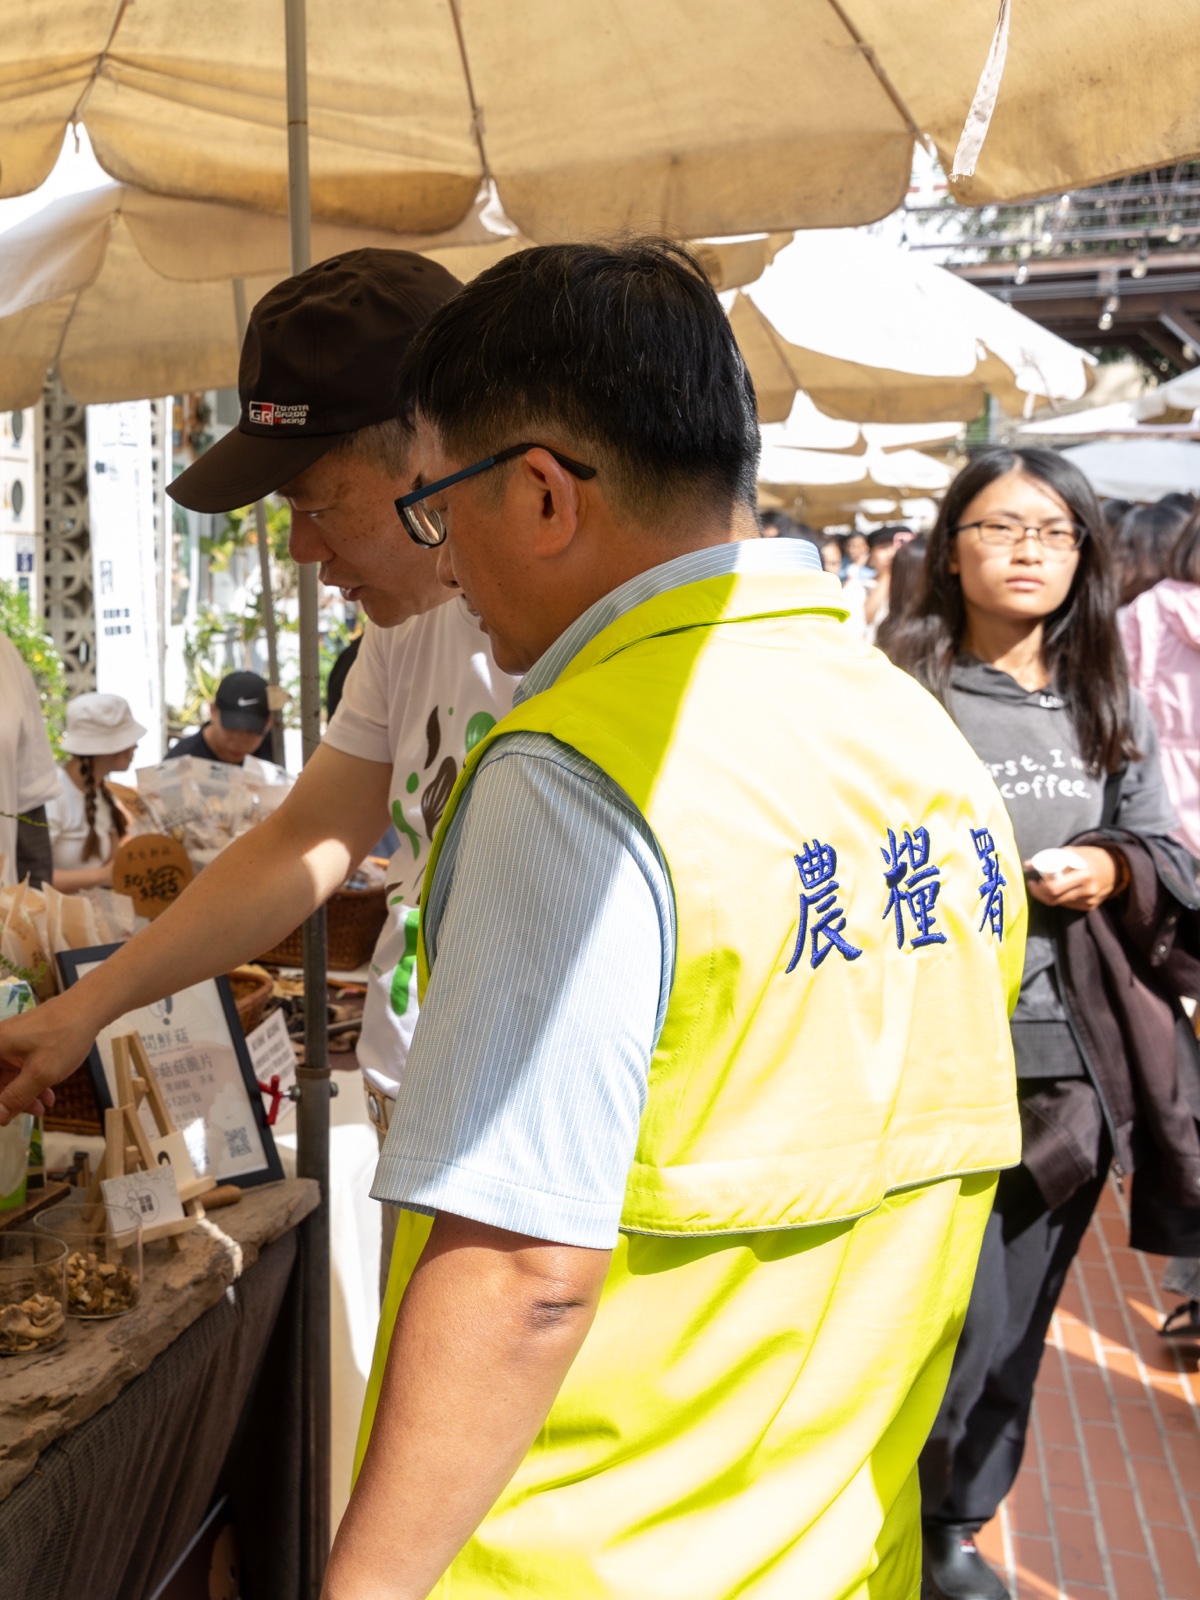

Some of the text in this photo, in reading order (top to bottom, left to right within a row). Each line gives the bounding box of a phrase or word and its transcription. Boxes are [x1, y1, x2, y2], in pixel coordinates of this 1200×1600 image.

[274, 404, 309, 412] TOYOTA
[274, 417, 307, 425] Racing
[785, 826, 1007, 974] 農糧署
